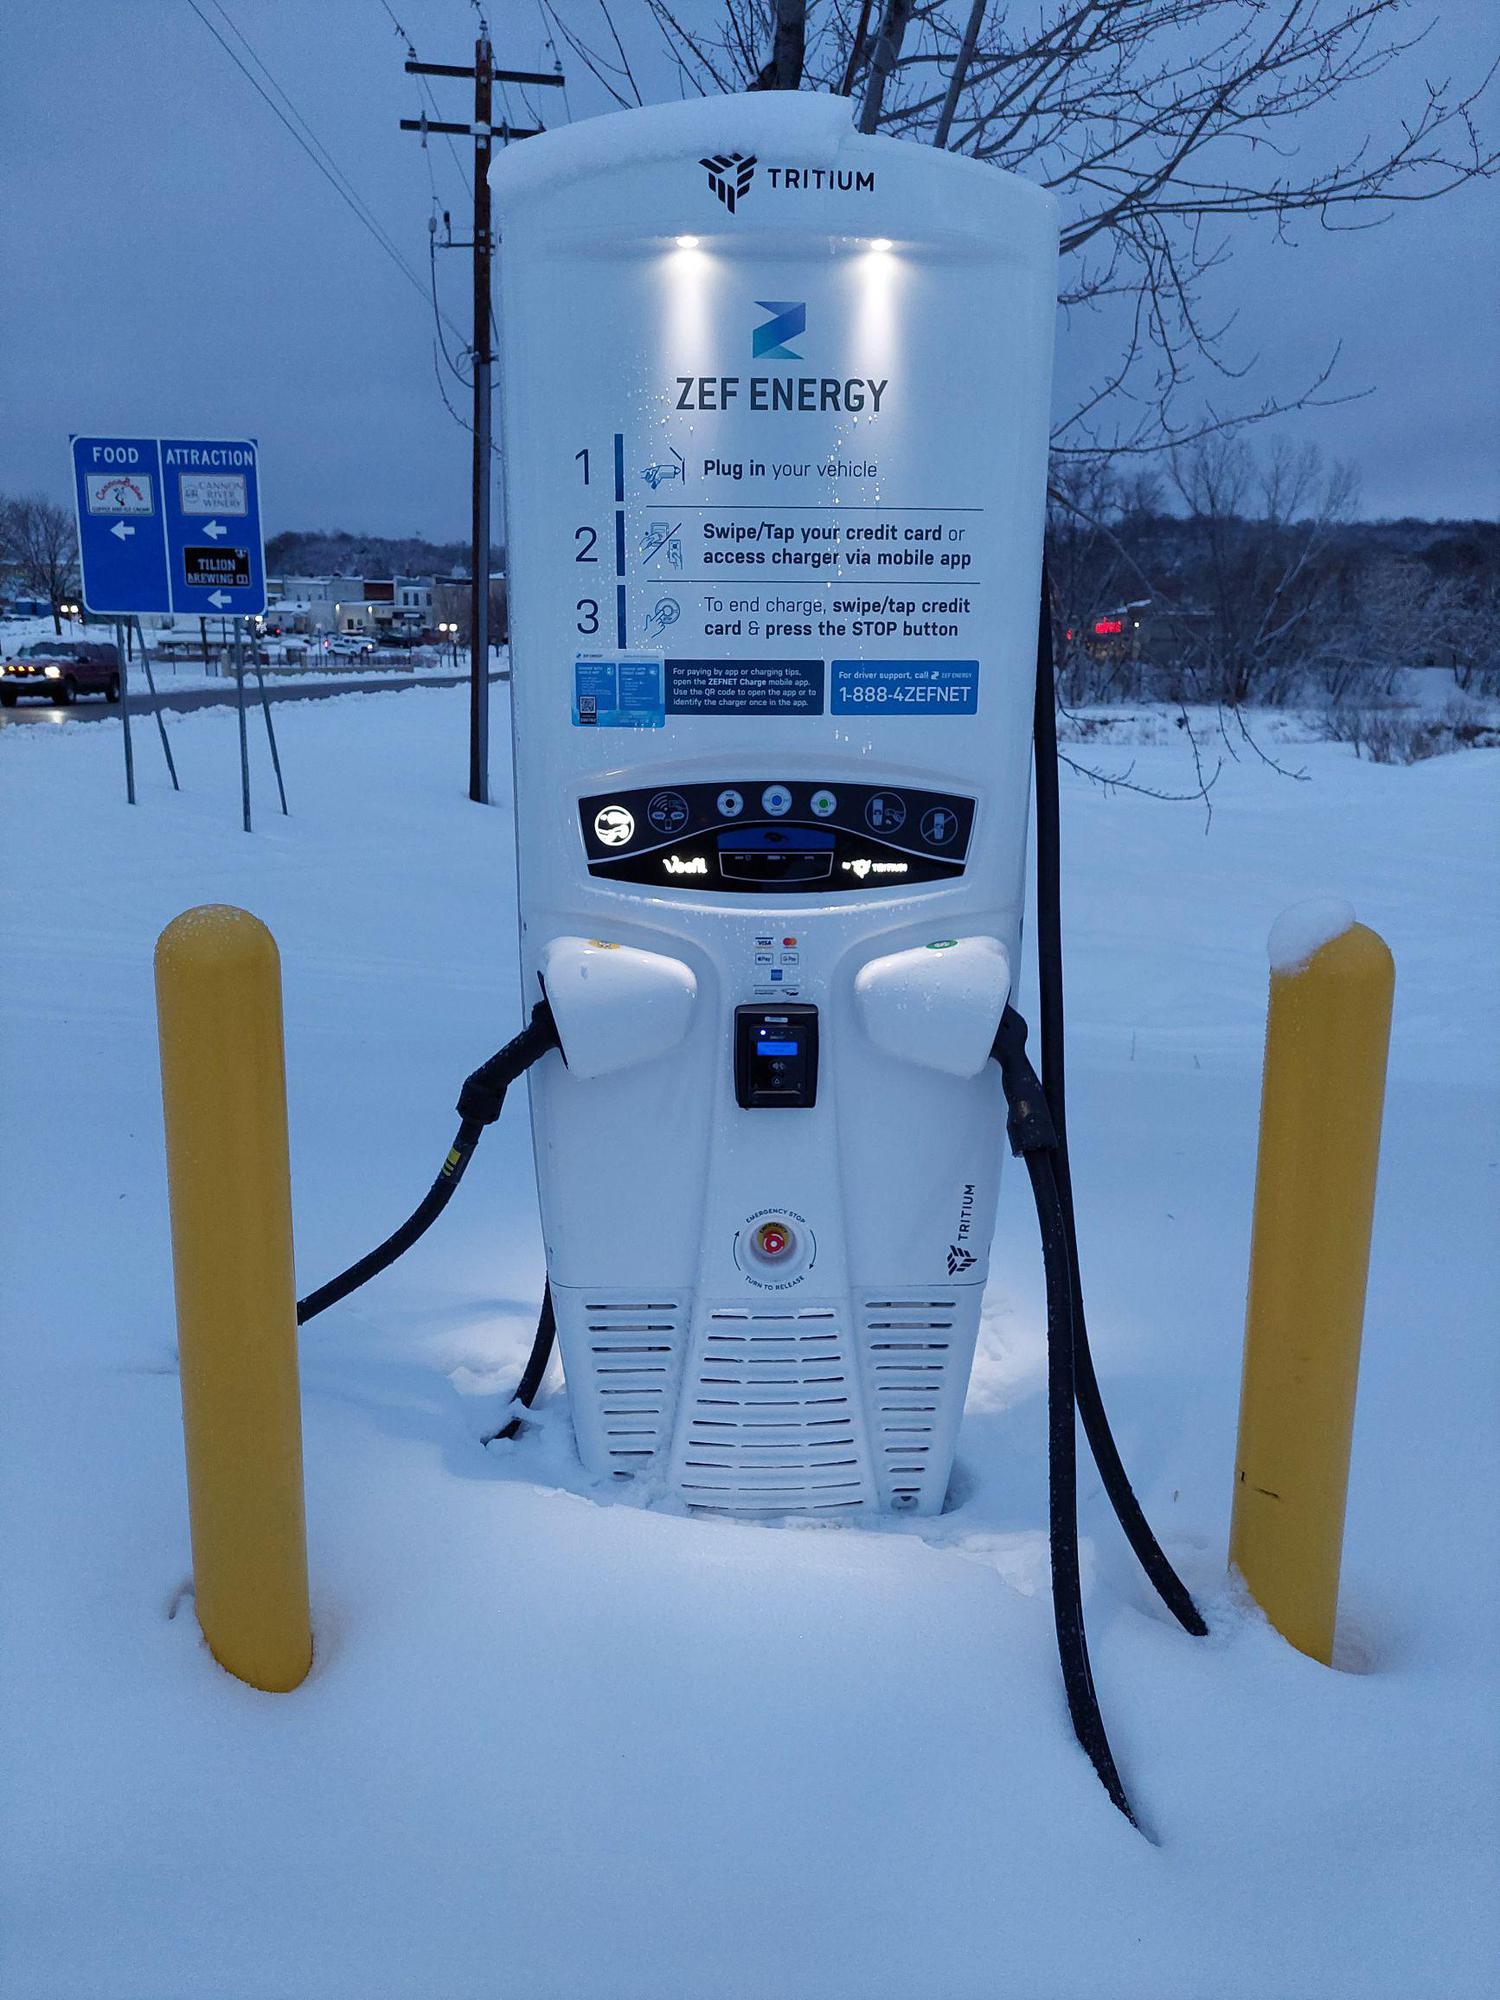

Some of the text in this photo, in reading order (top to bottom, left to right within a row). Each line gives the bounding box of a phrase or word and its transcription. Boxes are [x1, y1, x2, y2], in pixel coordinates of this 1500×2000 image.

[767, 168, 875, 192] TRITIUM
[676, 377, 889, 412] ZEF ENERGY
[92, 447, 139, 463] FOOD
[166, 450, 254, 466] ATTRACTION
[574, 448, 591, 486] 1
[703, 459, 878, 482] Plug in your vehicle
[703, 521, 966, 545] Swipe/Tap your credit card or
[574, 526, 598, 563] 2
[198, 558, 236, 571] TILION
[703, 548, 972, 569] access charger via mobile app
[187, 573, 234, 585] BREWING
[704, 596, 971, 618] To end charge, swipe/tap credit
[576, 598, 599, 634] 3
[704, 620, 958, 639] card & press the STOP button
[673, 667, 685, 675] For
[687, 668, 712, 677] paying
[714, 668, 722, 677] by
[725, 669, 739, 677] app
[750, 668, 783, 677] charging
[854, 671, 877, 679] driver
[673, 679, 692, 687] open
[708, 678, 737, 686] ZEFNET
[739, 678, 767, 687] Charge
[768, 678, 792, 686] mobile
[673, 688, 688, 696] Use
[690, 688, 703, 696] the
[704, 688, 716, 696] QR
[718, 688, 736, 696] code
[747, 689, 766, 697] open
[768, 688, 781, 696] the
[839, 686, 972, 703] 1-888-4ZEFNET
[673, 698, 702, 707] identify
[704, 698, 717, 706] the
[718, 698, 747, 707] charger
[745, 1208, 806, 1224] EMERGENCY STOP
[957, 1184, 976, 1241] TRITIUM
[744, 1275, 763, 1289] TURN
[775, 1275, 805, 1291] RELEASE
